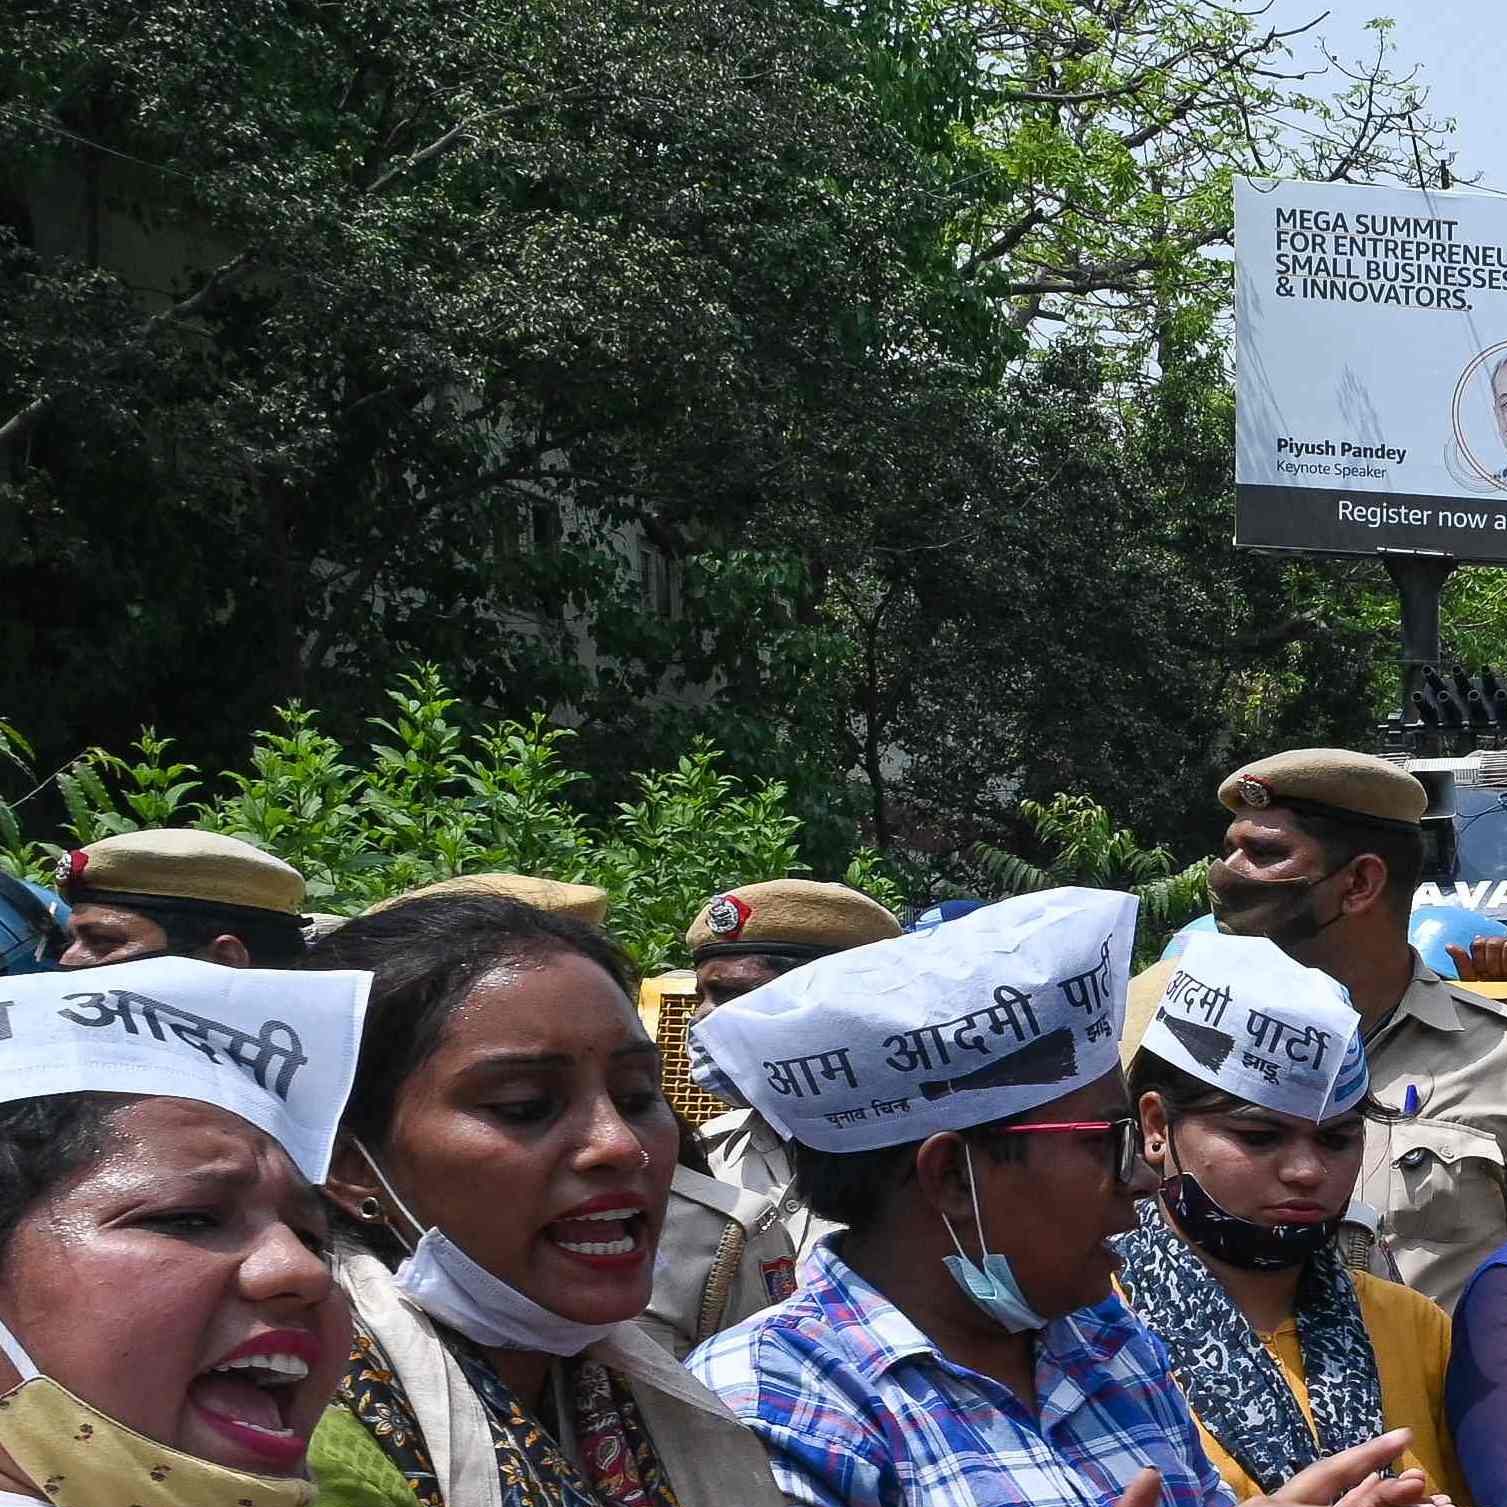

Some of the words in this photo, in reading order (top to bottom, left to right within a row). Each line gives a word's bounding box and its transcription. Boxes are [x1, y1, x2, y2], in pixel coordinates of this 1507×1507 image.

[1276, 207, 1349, 233] MEGA
[1356, 214, 1458, 241] SUMMIT
[1276, 231, 1326, 254] FOR
[1276, 253, 1359, 279] SMALL
[1275, 276, 1295, 298] &
[1302, 277, 1473, 310] INNOVATORS.
[1276, 438, 1336, 458] Piyush
[1340, 442, 1407, 464] Pandey
[1276, 460, 1331, 476] Keynote
[1334, 463, 1387, 479] Speaker
[1337, 500, 1433, 527] Register
[1438, 511, 1488, 528] now
[57, 988, 309, 1103] आदमी
[762, 1047, 858, 1098] आम
[882, 985, 1042, 1072] आदमी
[1246, 1008, 1331, 1071] पार्टी
